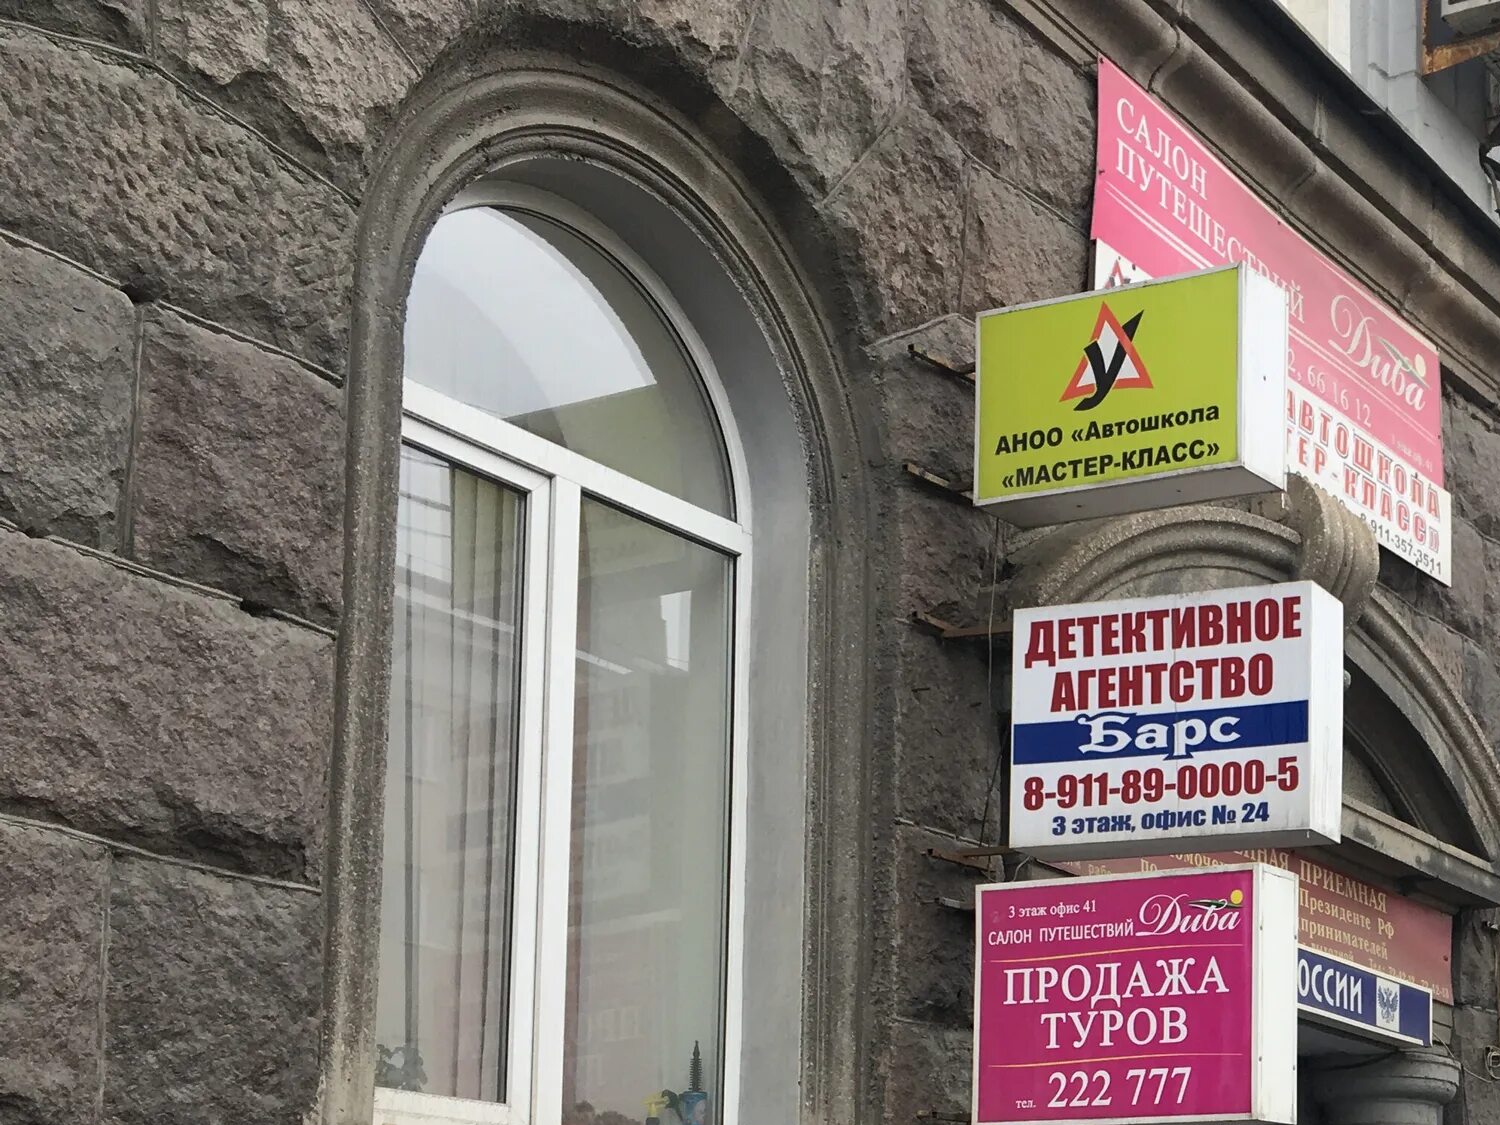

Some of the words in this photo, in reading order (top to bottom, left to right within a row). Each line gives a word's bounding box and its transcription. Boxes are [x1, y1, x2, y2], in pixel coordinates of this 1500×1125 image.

[1116, 97, 1208, 200] САЛОН
[1308, 365, 1326, 393] 66
[1332, 382, 1349, 410] 16
[1356, 398, 1371, 427] 12
[995, 427, 1063, 455] АНОО
[1071, 404, 1220, 443] «Автошкола
[1002, 439, 1220, 488] «МАСТЕР-КЛАСС»
[1024, 596, 1302, 669] ДЕТЕКТИВНОЕ
[1050, 653, 1273, 712] АГЕНТСТВО
[1077, 713, 1241, 757] Барс
[1023, 756, 1299, 811] 8-911-89-0000-5
[1052, 815, 1066, 836] 3
[1072, 815, 1135, 834] этаж,
[1141, 809, 1206, 830] офис
[1212, 805, 1236, 825] №
[1242, 802, 1269, 823] 24
[1008, 905, 1016, 919] 3
[1018, 906, 1047, 918] этаж
[1050, 902, 1080, 920] офис
[1083, 900, 1097, 912] 41
[1300, 859, 1388, 913] ПРИЕМНАЯ
[988, 928, 1032, 945] САЛОН
[1039, 919, 1134, 942] ПУТЕШЕСТВИЙ
[1299, 887, 1372, 931] Президенте
[1377, 917, 1395, 940] РФ
[1003, 956, 1229, 1009] ПРОДАЖА
[1040, 1006, 1188, 1049] ТУРОВ
[1016, 1098, 1036, 1109] тел.
[1048, 1070, 1112, 1108] 222
[1126, 1067, 1192, 1105] 777
